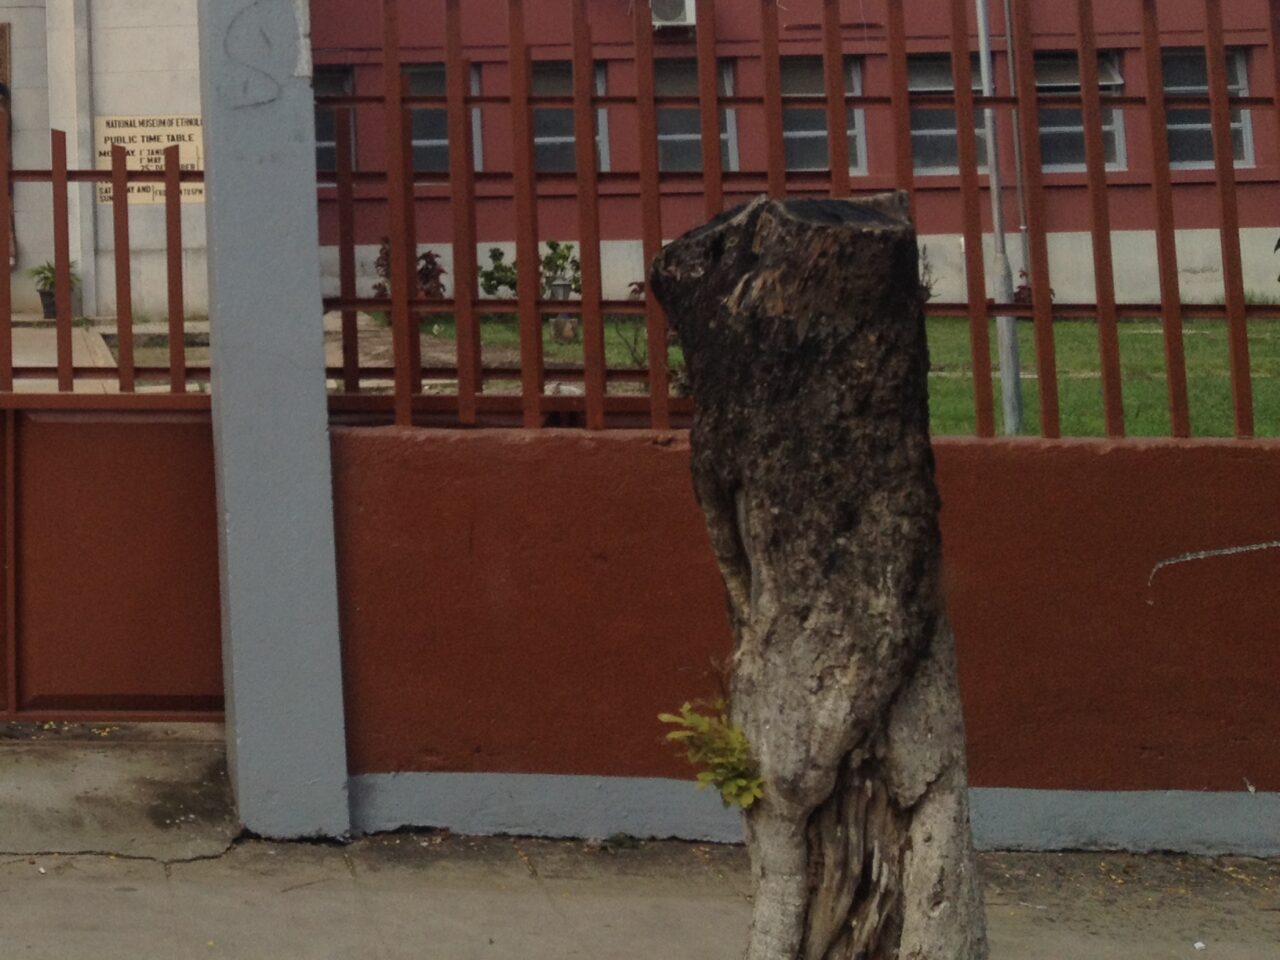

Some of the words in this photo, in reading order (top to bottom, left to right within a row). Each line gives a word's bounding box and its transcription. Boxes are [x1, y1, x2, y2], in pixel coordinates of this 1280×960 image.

[105, 119, 137, 128] NATIONAL
[138, 118, 166, 127] MUSEUM
[167, 118, 175, 127] OF
[176, 117, 203, 126] ETHNOL
[104, 135, 137, 144] PUBLIC
[140, 134, 163, 143] TIME
[165, 133, 195, 142] TABLE
[147, 156, 162, 164] MAY
[137, 185, 151, 194] AND
